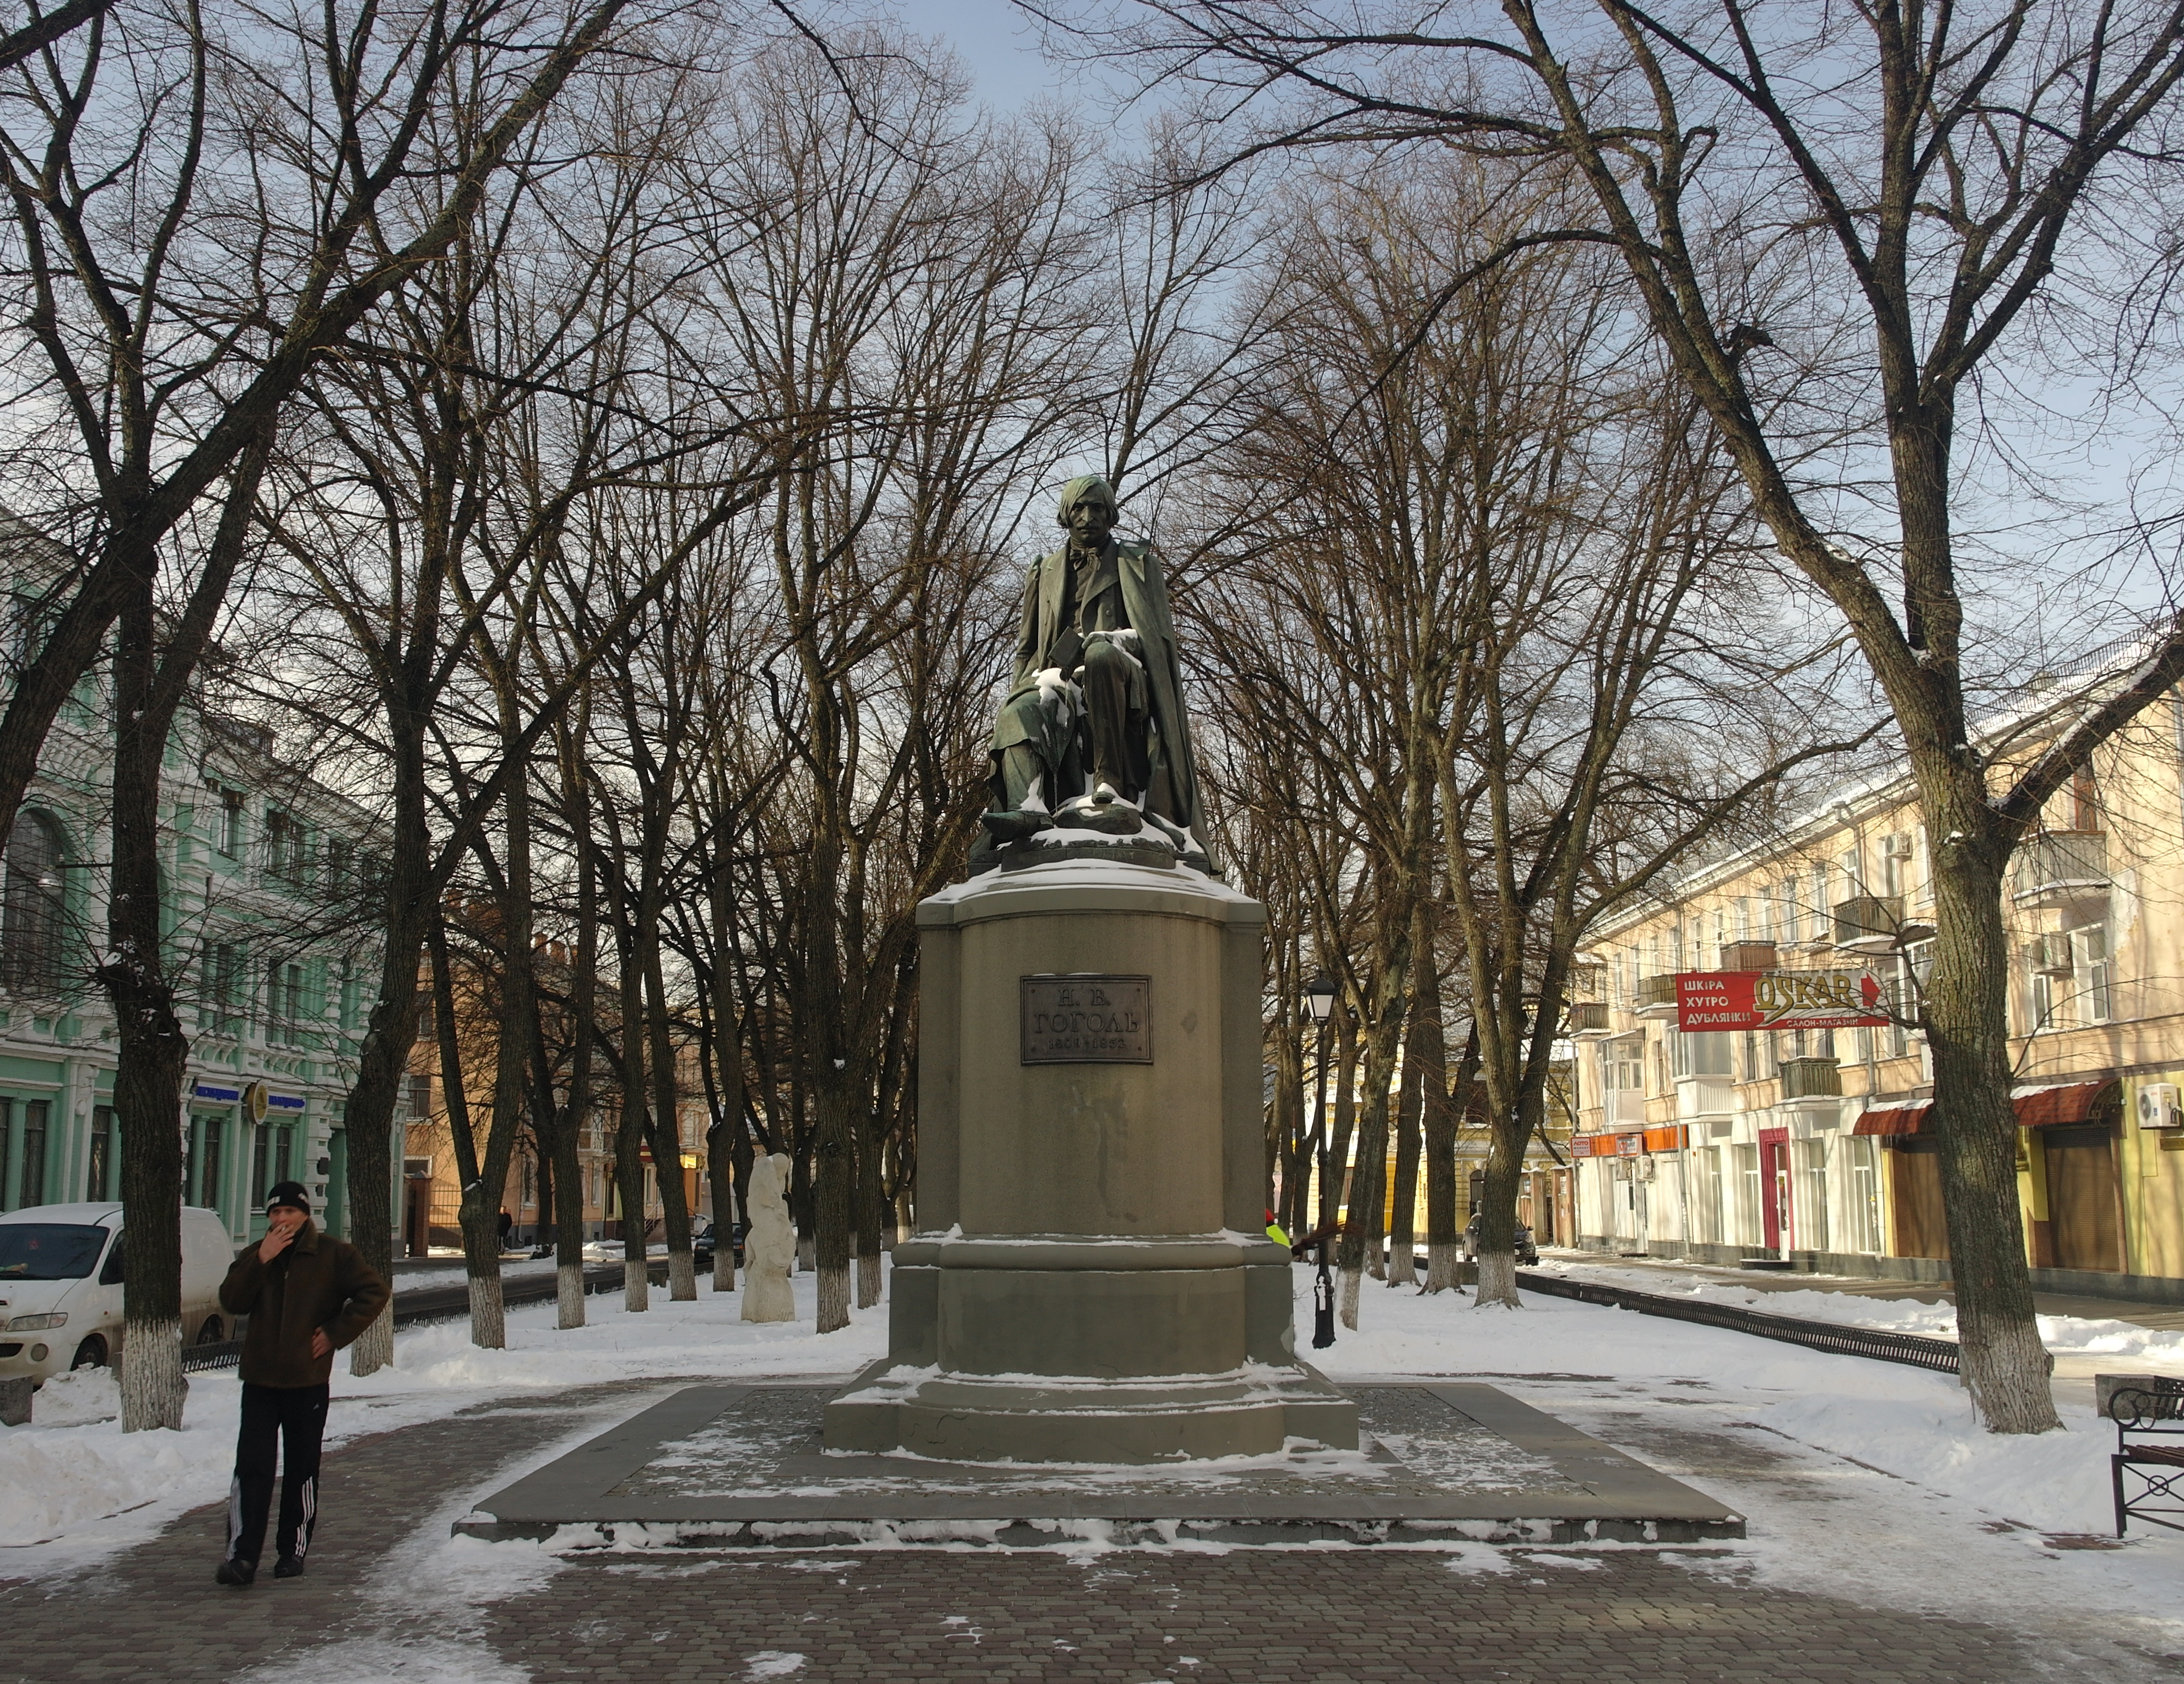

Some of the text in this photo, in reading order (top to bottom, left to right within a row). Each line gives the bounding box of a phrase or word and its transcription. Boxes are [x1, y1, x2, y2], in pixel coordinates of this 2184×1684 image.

[1684, 980, 1725, 991] ШКІРА
[1057, 989, 1111, 1006] Н. В.
[1686, 996, 1729, 1007] ХУТРО
[1754, 975, 1858, 1025] OSKAR
[1034, 1012, 1140, 1034] ГОГОЛЬ
[1686, 1012, 1751, 1025] ДУБЛЯНКИ
[1786, 1018, 1858, 1028] САЛОН-МАГАЗИН
